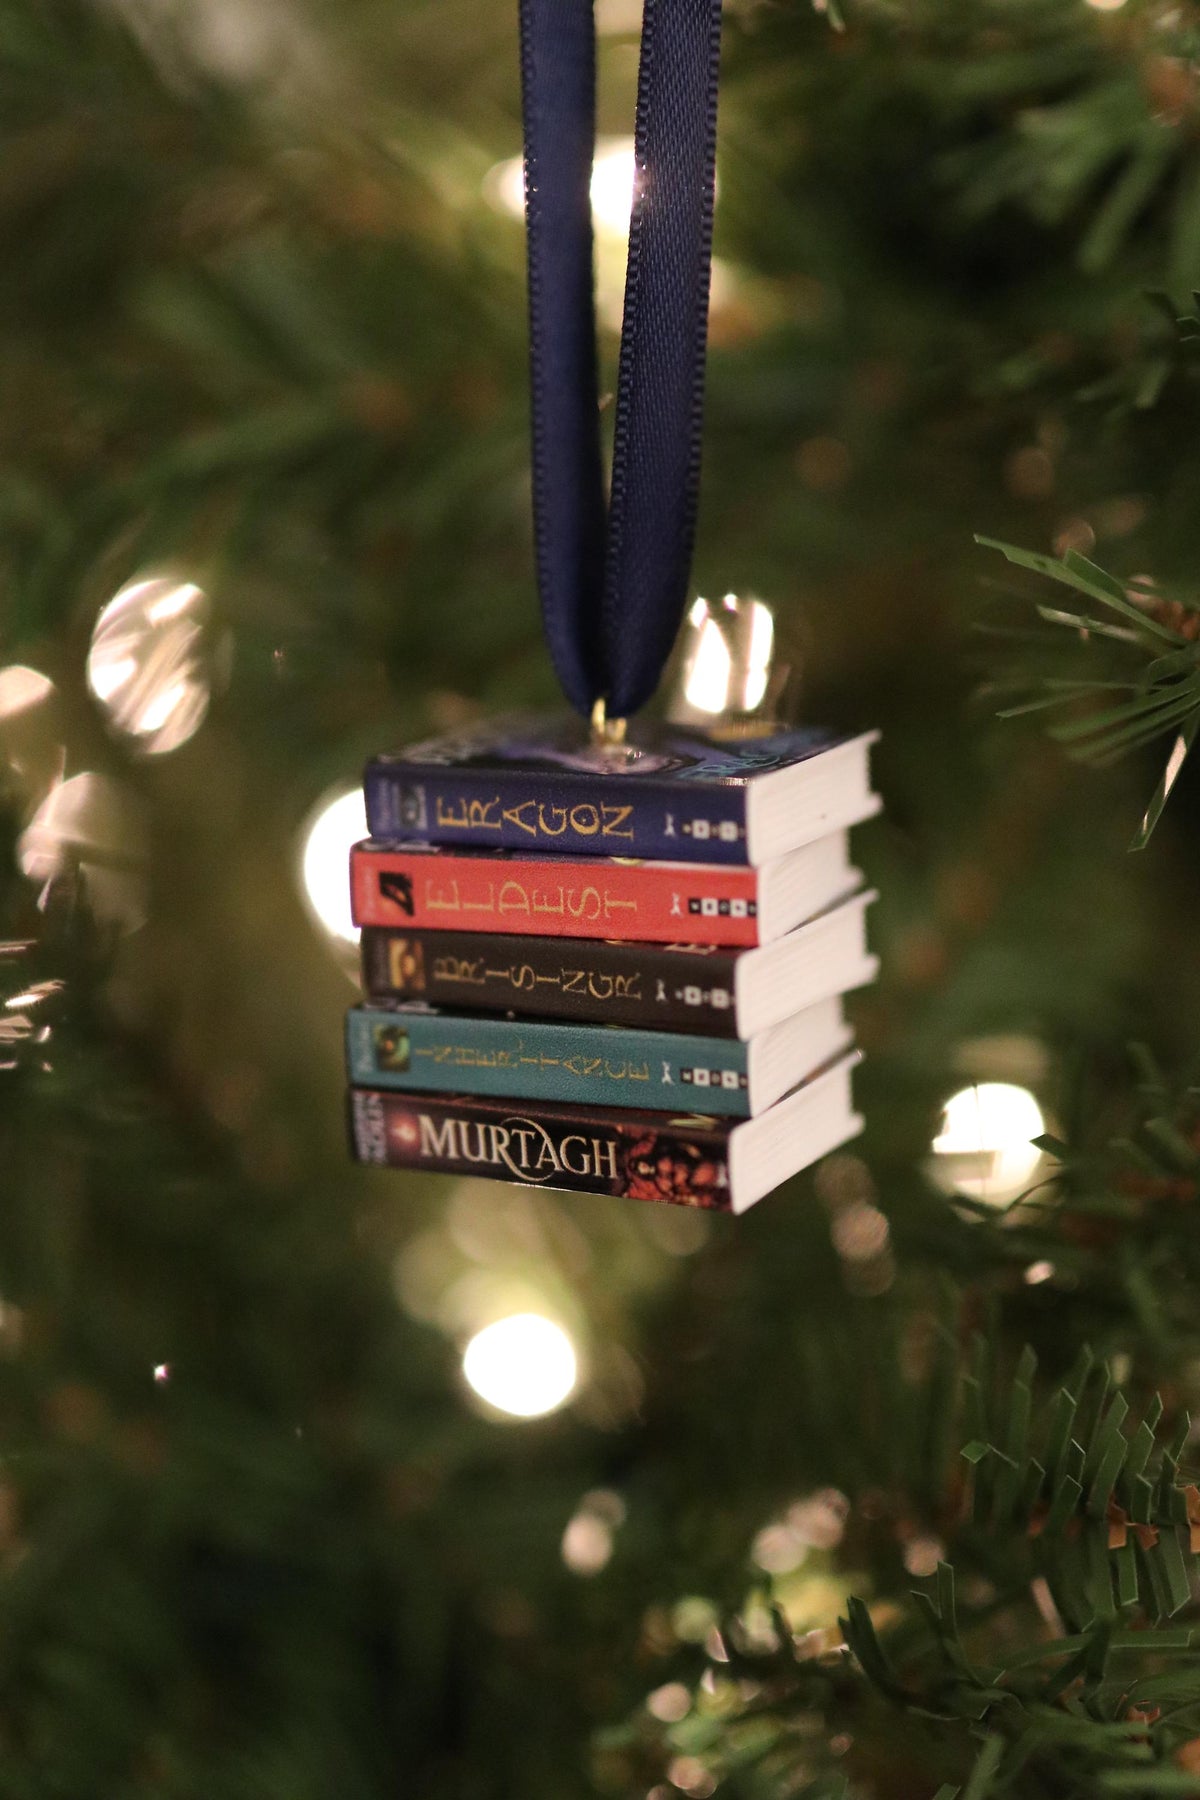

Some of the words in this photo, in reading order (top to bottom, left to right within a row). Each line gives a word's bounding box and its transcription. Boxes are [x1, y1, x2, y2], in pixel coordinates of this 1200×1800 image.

[436, 796, 634, 841] ERAGON
[425, 879, 637, 920] ELDEST
[434, 957, 642, 1000] BRISINGR
[418, 1114, 618, 1182] MURTAGH
